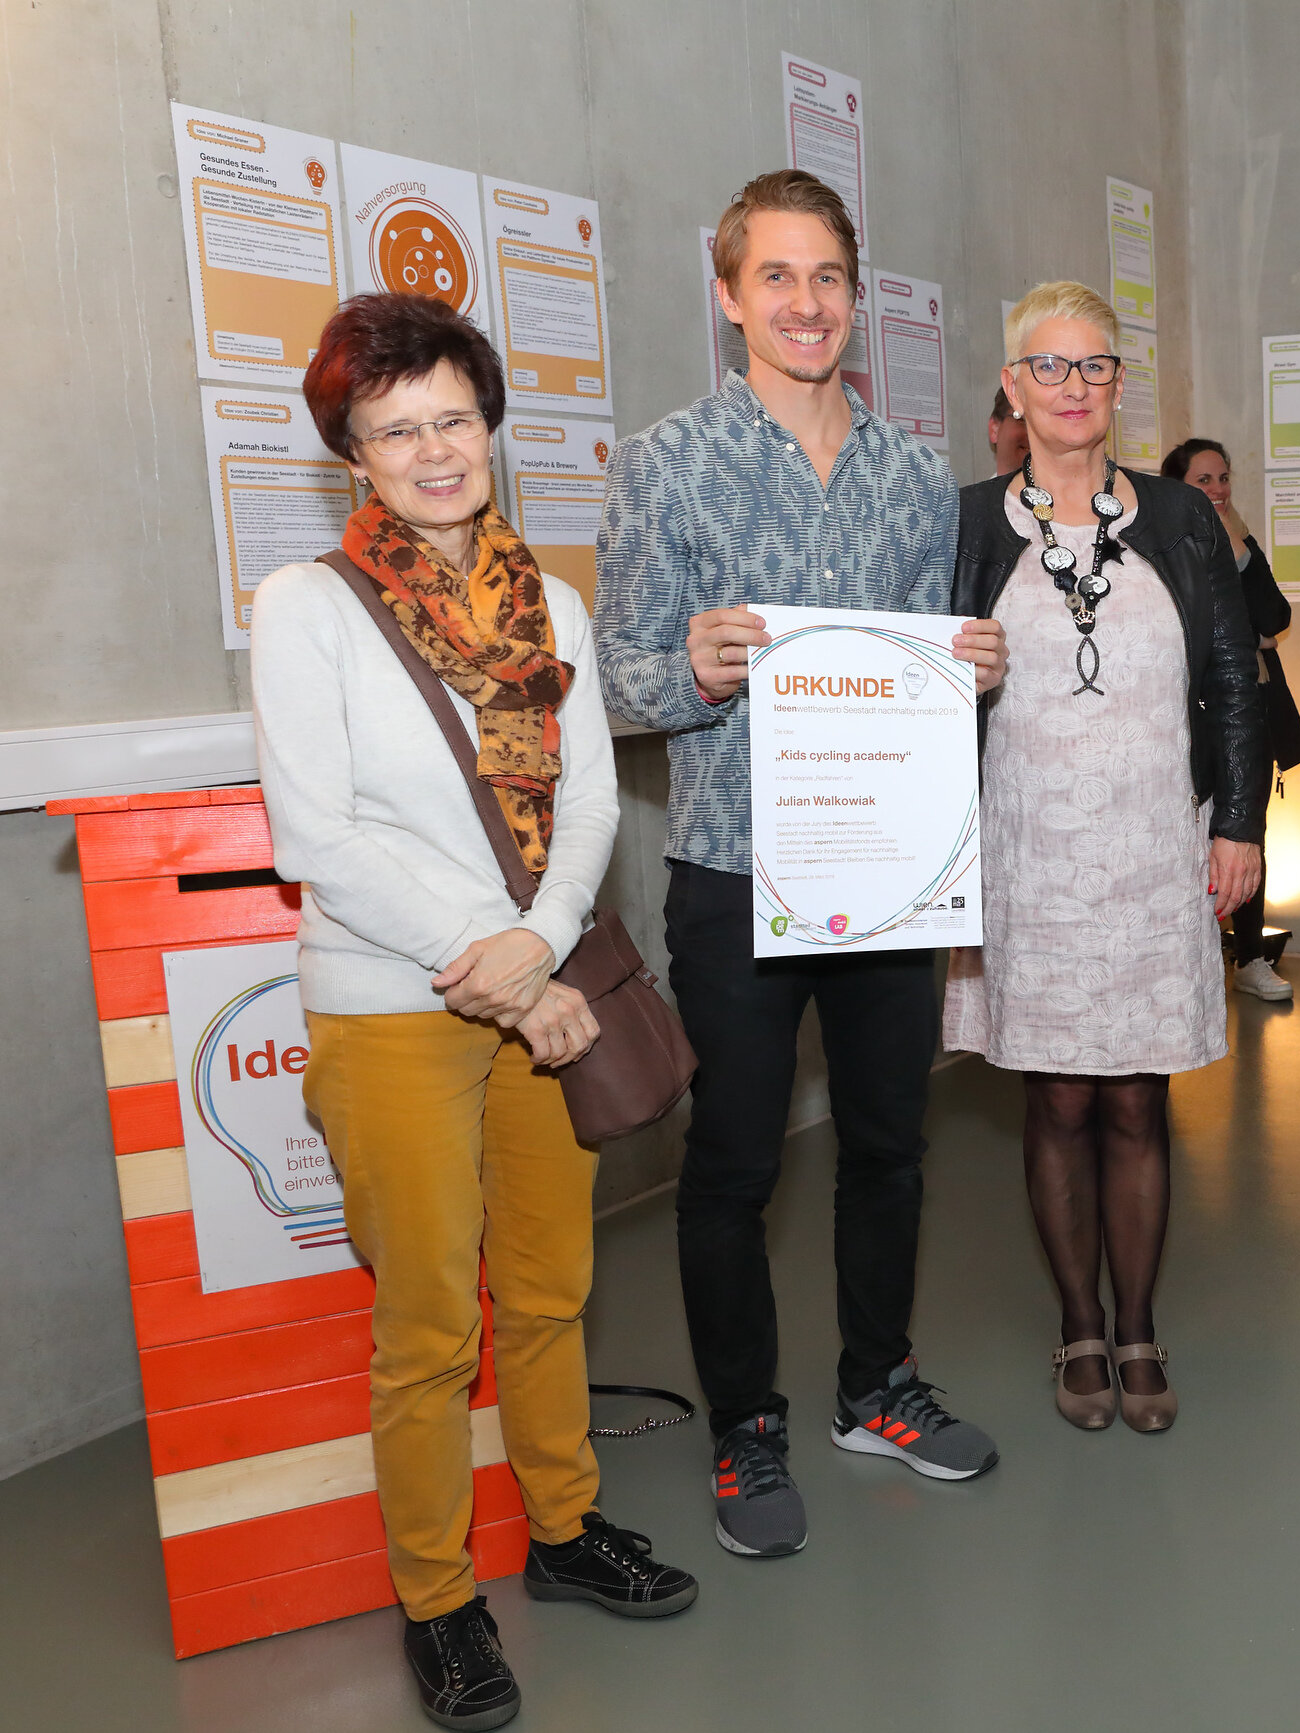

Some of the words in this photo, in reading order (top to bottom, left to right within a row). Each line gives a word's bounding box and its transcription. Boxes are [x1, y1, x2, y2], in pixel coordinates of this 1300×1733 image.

[200, 152, 239, 169] Gesundes
[241, 161, 264, 173] Essen
[201, 164, 236, 178] Gesunde
[237, 171, 278, 188] Zustellung
[355, 181, 427, 225] Nahversorgung
[228, 441, 260, 451] Adamah
[261, 444, 289, 453] Biokistl
[520, 459, 550, 468] PopUpPub
[556, 461, 578, 470] Brewery
[774, 674, 895, 698] URKUNDE
[773, 704, 842, 714] Ideenwettbewerb
[843, 705, 876, 715] Seestadt
[878, 707, 916, 716] nachhaltig
[916, 707, 938, 715] mobil
[938, 708, 959, 716] 2019
[775, 750, 807, 762] „Kids
[809, 750, 851, 763] cycling
[853, 750, 912, 763] academy“
[776, 796, 811, 807] Julian
[813, 795, 876, 806] Walkowiak
[286, 1137, 318, 1151] Ihre
[287, 1155, 326, 1171] bitte
